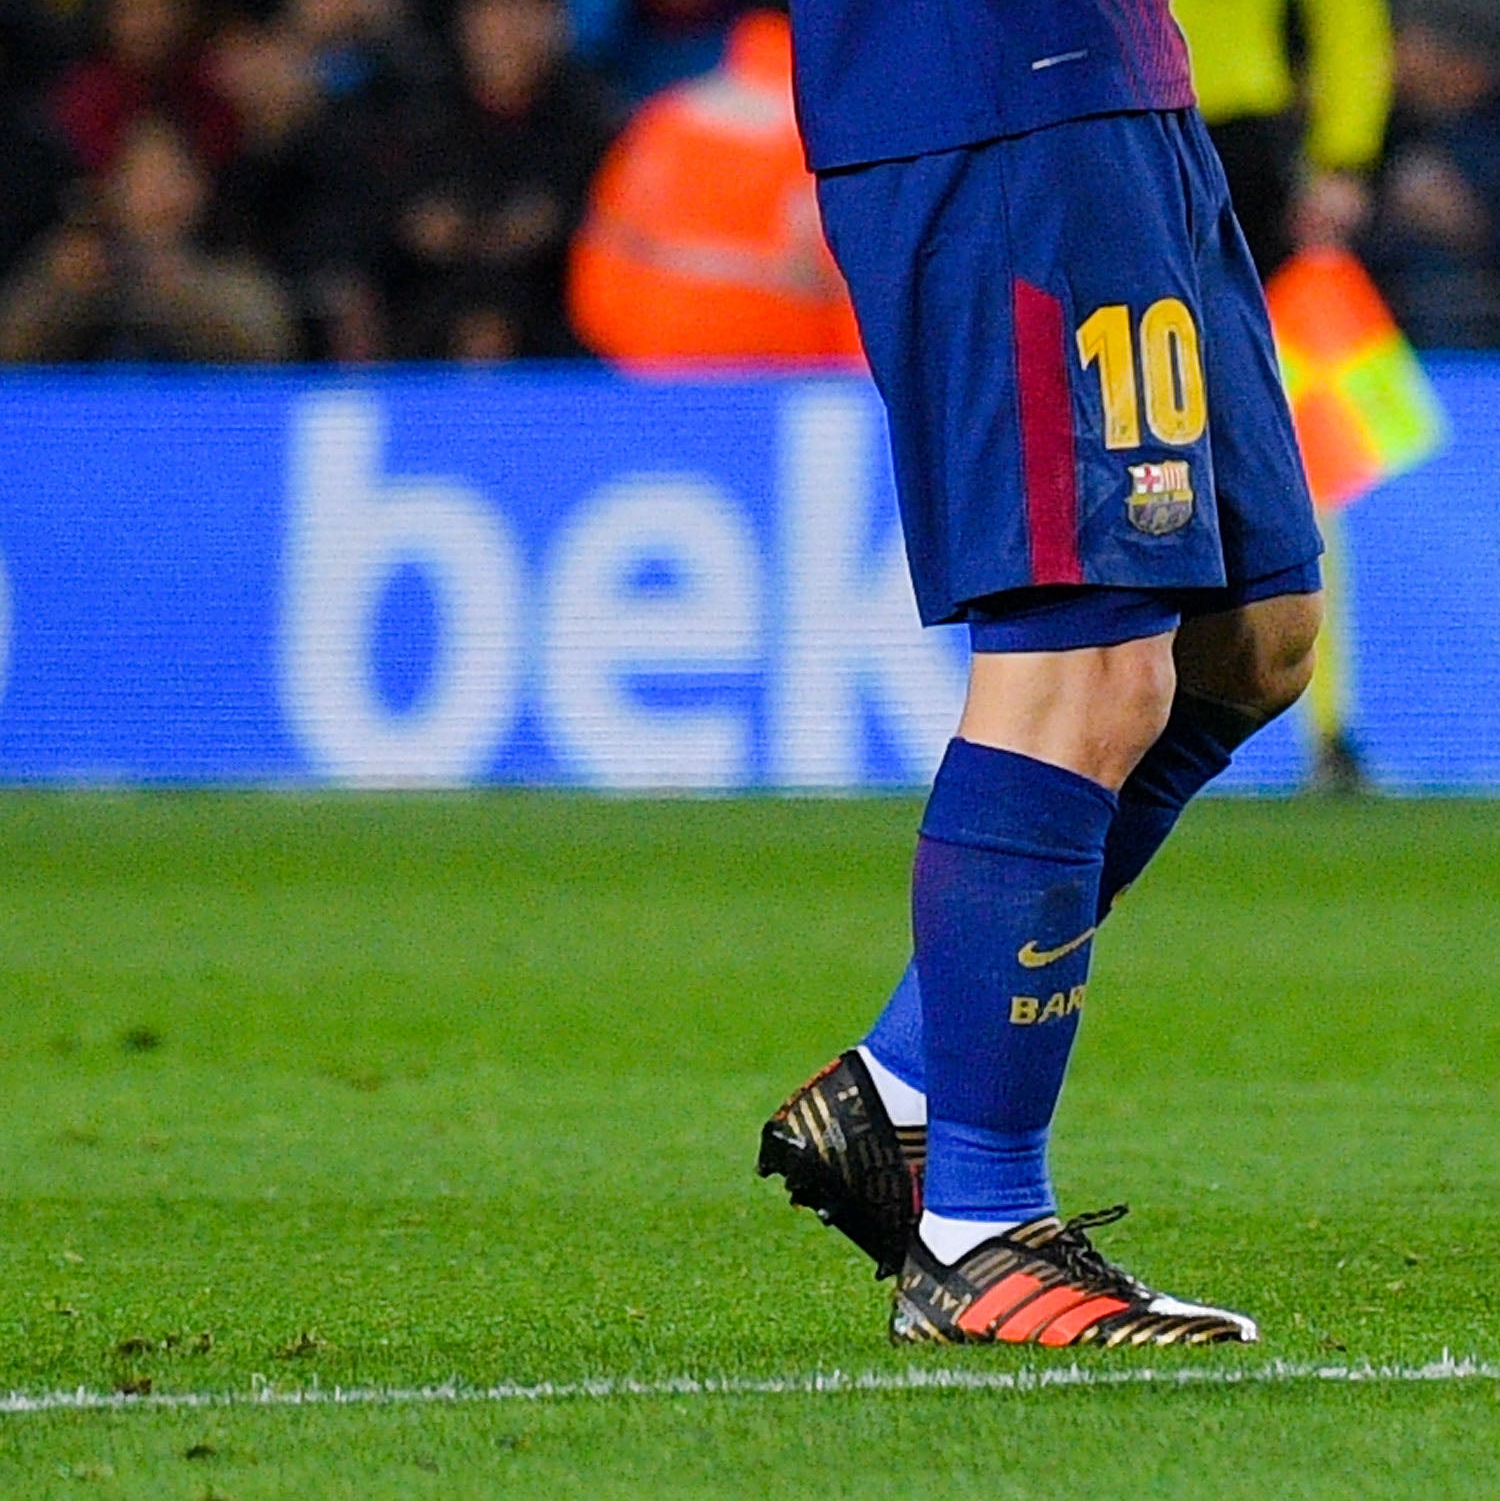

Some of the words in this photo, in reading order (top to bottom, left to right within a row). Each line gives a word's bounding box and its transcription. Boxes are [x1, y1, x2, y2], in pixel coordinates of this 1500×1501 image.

[1075, 297, 1208, 450] 10
[278, 388, 972, 790] bek
[1008, 984, 1089, 1025] BAR
